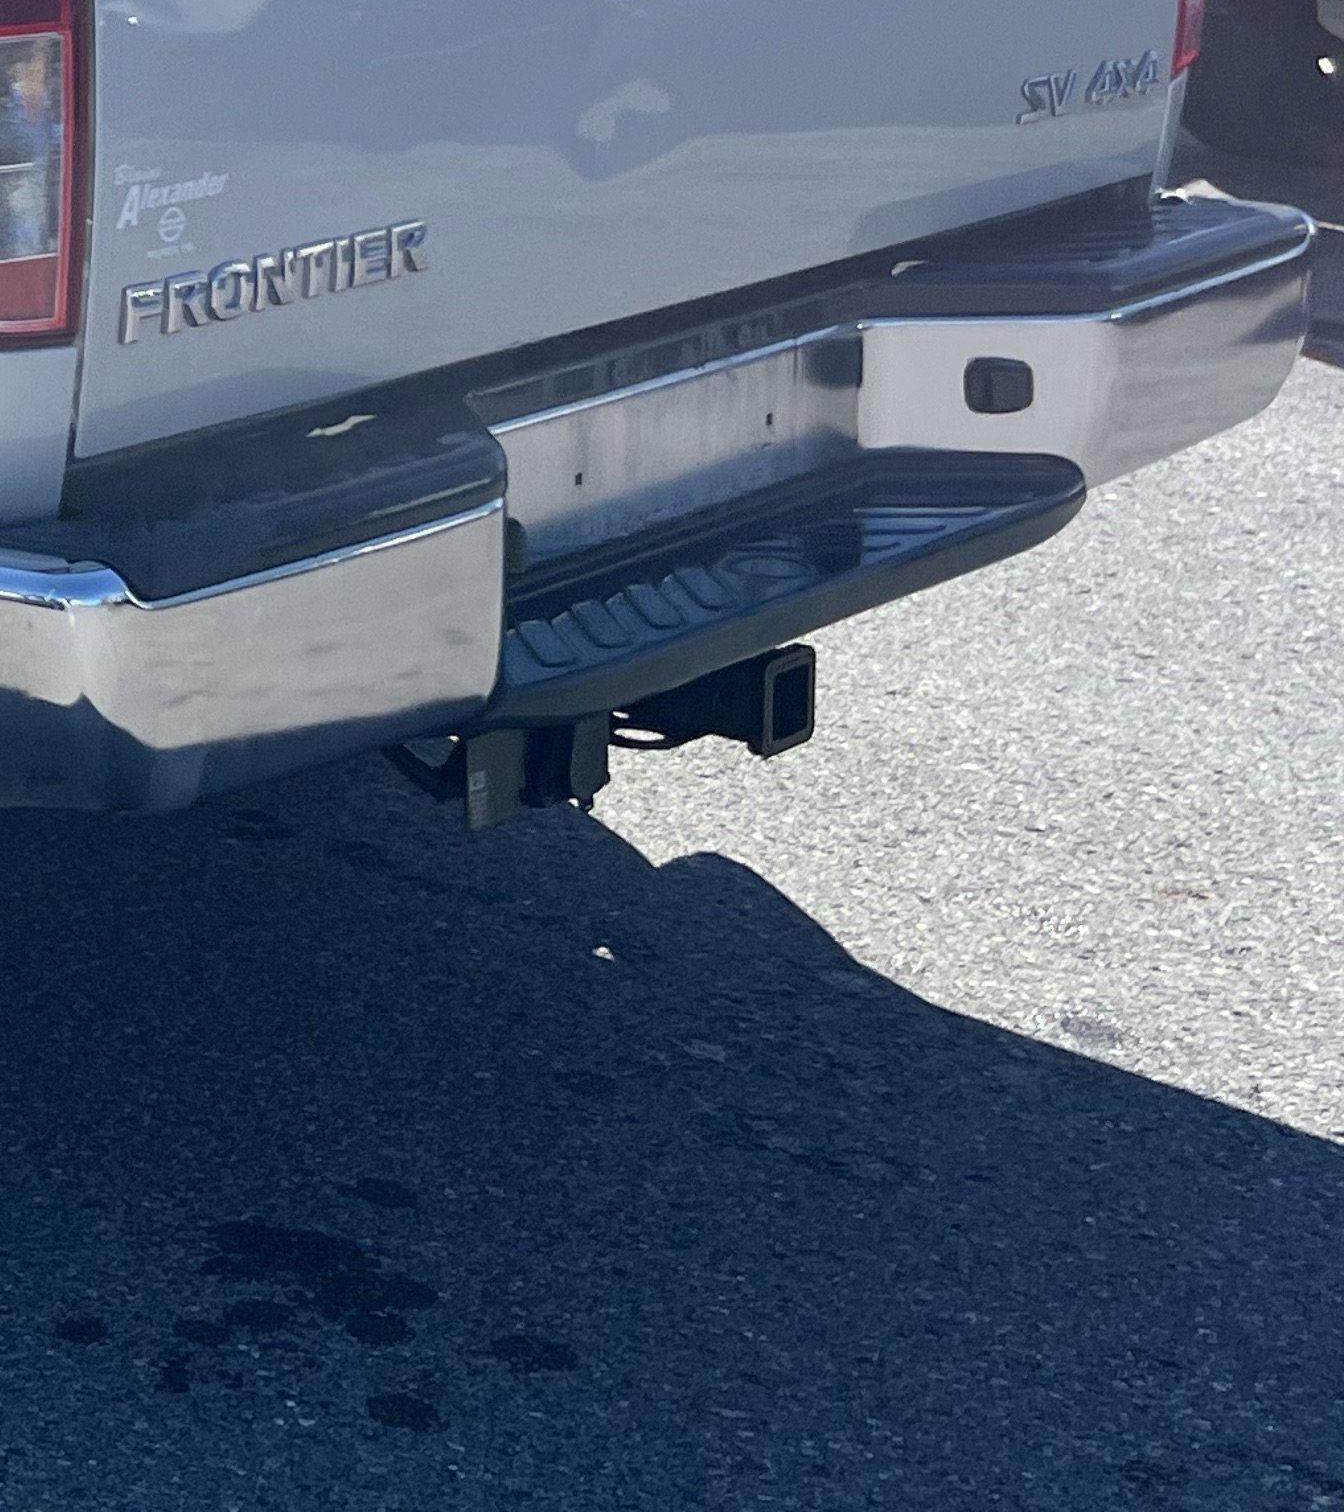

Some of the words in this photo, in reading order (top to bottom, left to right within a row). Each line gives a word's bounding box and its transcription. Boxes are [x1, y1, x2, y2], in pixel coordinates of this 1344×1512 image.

[1015, 69, 1077, 125] SV
[117, 172, 228, 228] Alexander
[118, 219, 429, 345] FRONTIER
